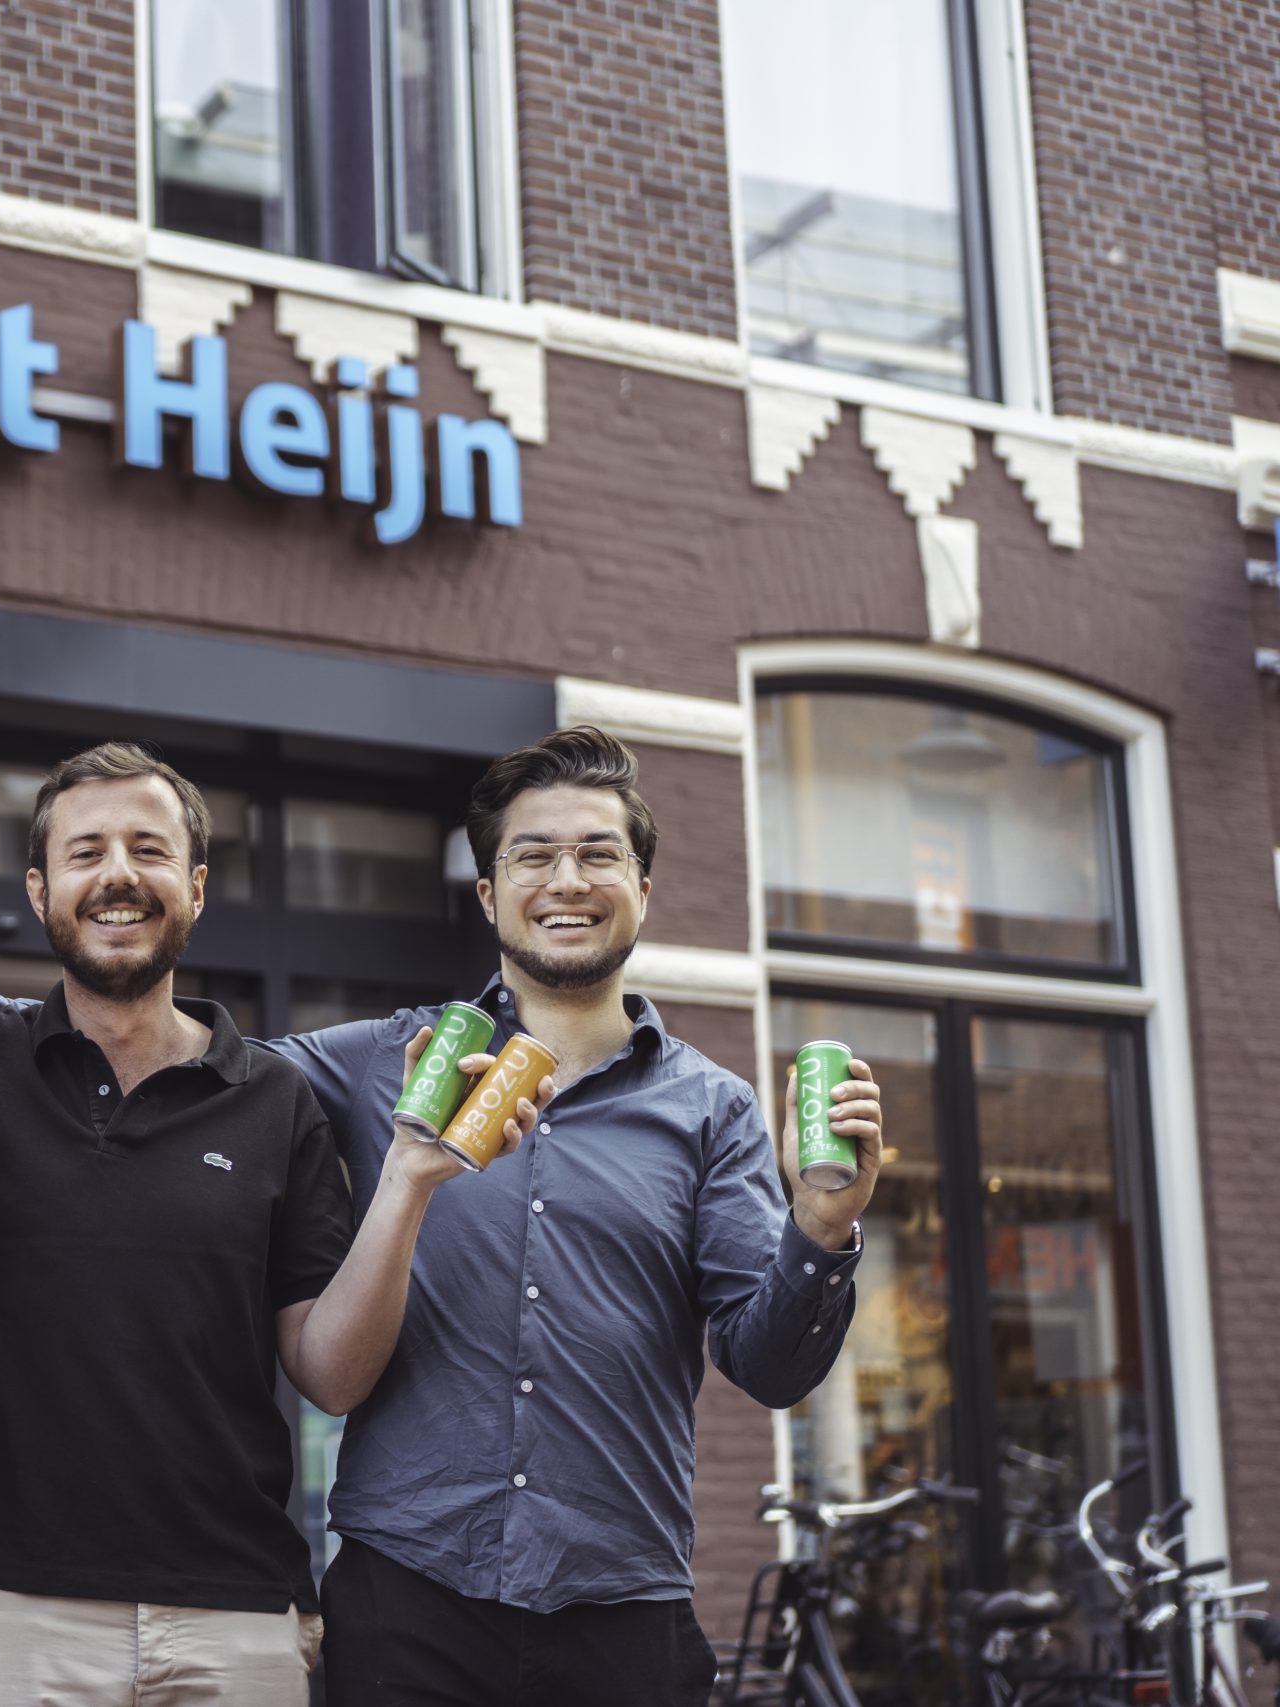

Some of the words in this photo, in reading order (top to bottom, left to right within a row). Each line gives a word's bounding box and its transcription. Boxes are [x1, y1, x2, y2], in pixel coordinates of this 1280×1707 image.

[123, 318, 521, 544] Heijn
[412, 1015, 468, 1097] BOZU
[463, 1048, 529, 1132] BOZU
[423, 1101, 441, 1115] TEA
[801, 1056, 824, 1143] BOZU
[470, 1135, 487, 1151] TEA
[820, 1143, 840, 1152] TEA
